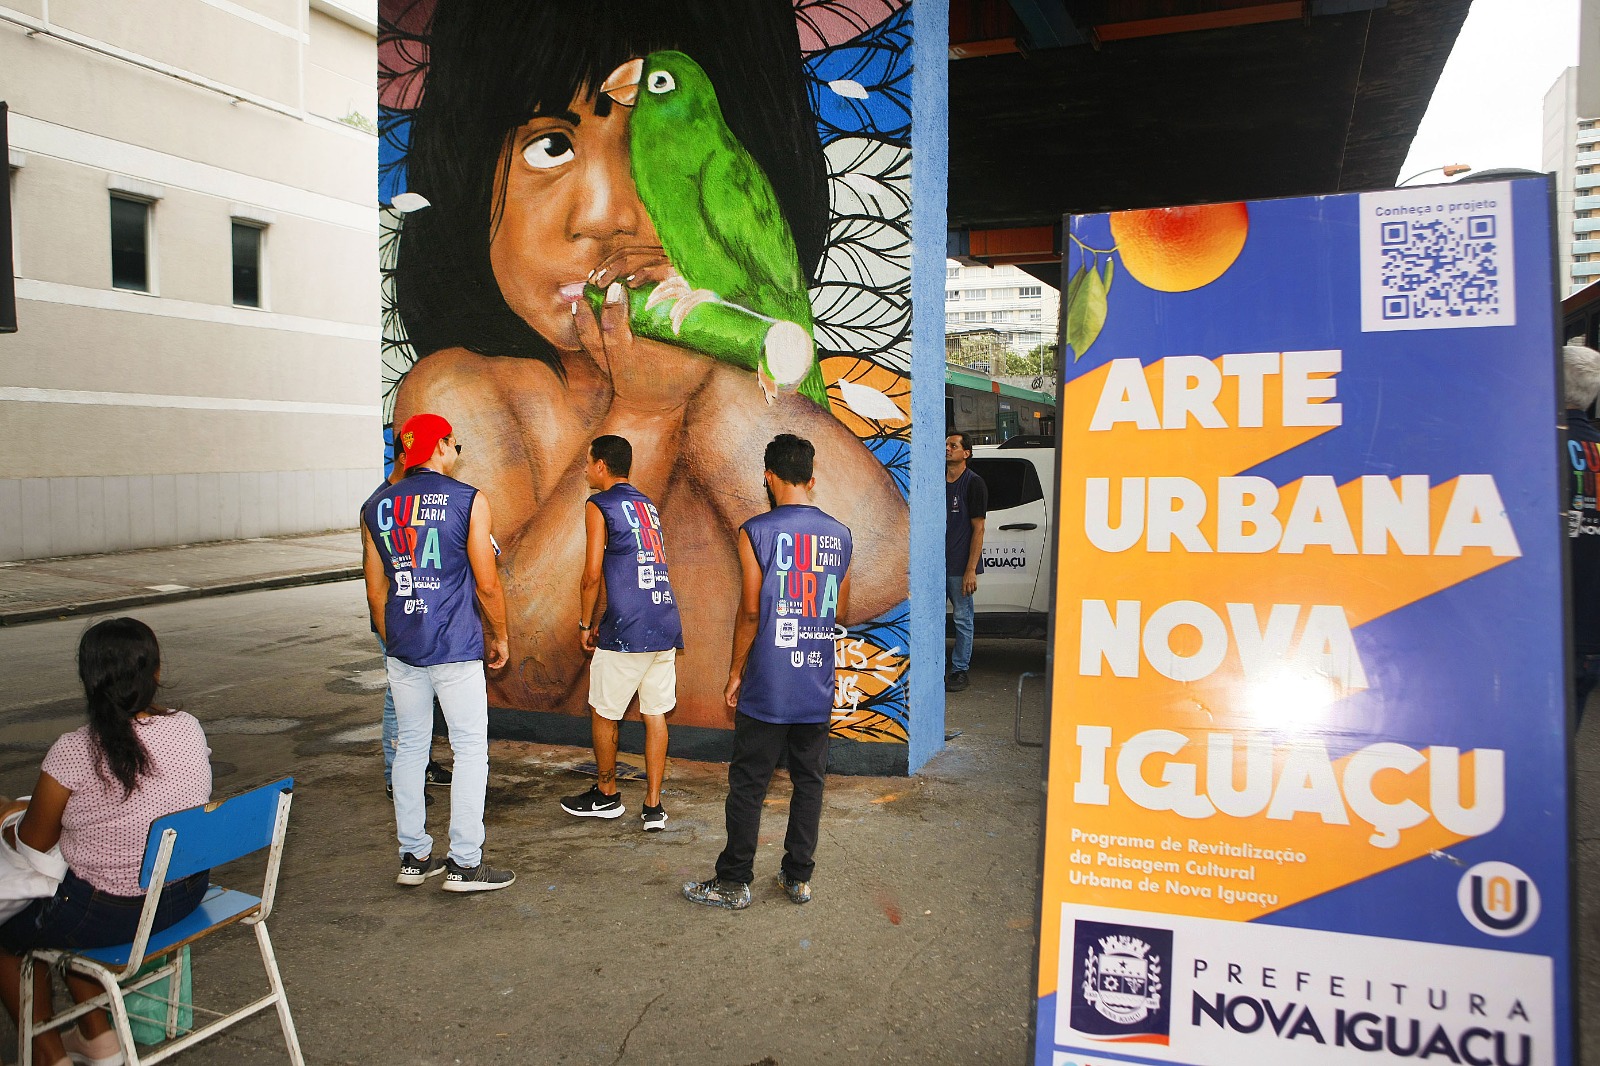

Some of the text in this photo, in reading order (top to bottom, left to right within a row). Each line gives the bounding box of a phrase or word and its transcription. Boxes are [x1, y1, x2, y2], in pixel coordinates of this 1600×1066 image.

[1375, 200, 1497, 217] Conheça o projeto
[1089, 349, 1342, 431] ARTE
[1084, 474, 1522, 557] URBANA
[631, 528, 667, 563] TUR
[984, 557, 1026, 569] IGUAÇU
[1079, 599, 1370, 689] NOVA
[1073, 724, 1505, 849] IGUAÇU
[1069, 849, 1255, 880] da Paisagem Cultural
[1071, 828, 1307, 865] Programa de Revitalização
[1069, 870, 1278, 907] Urbana de Nova Iguaçu
[1193, 958, 1531, 1022] PREFEITURA
[1191, 989, 1327, 1044] NOVA
